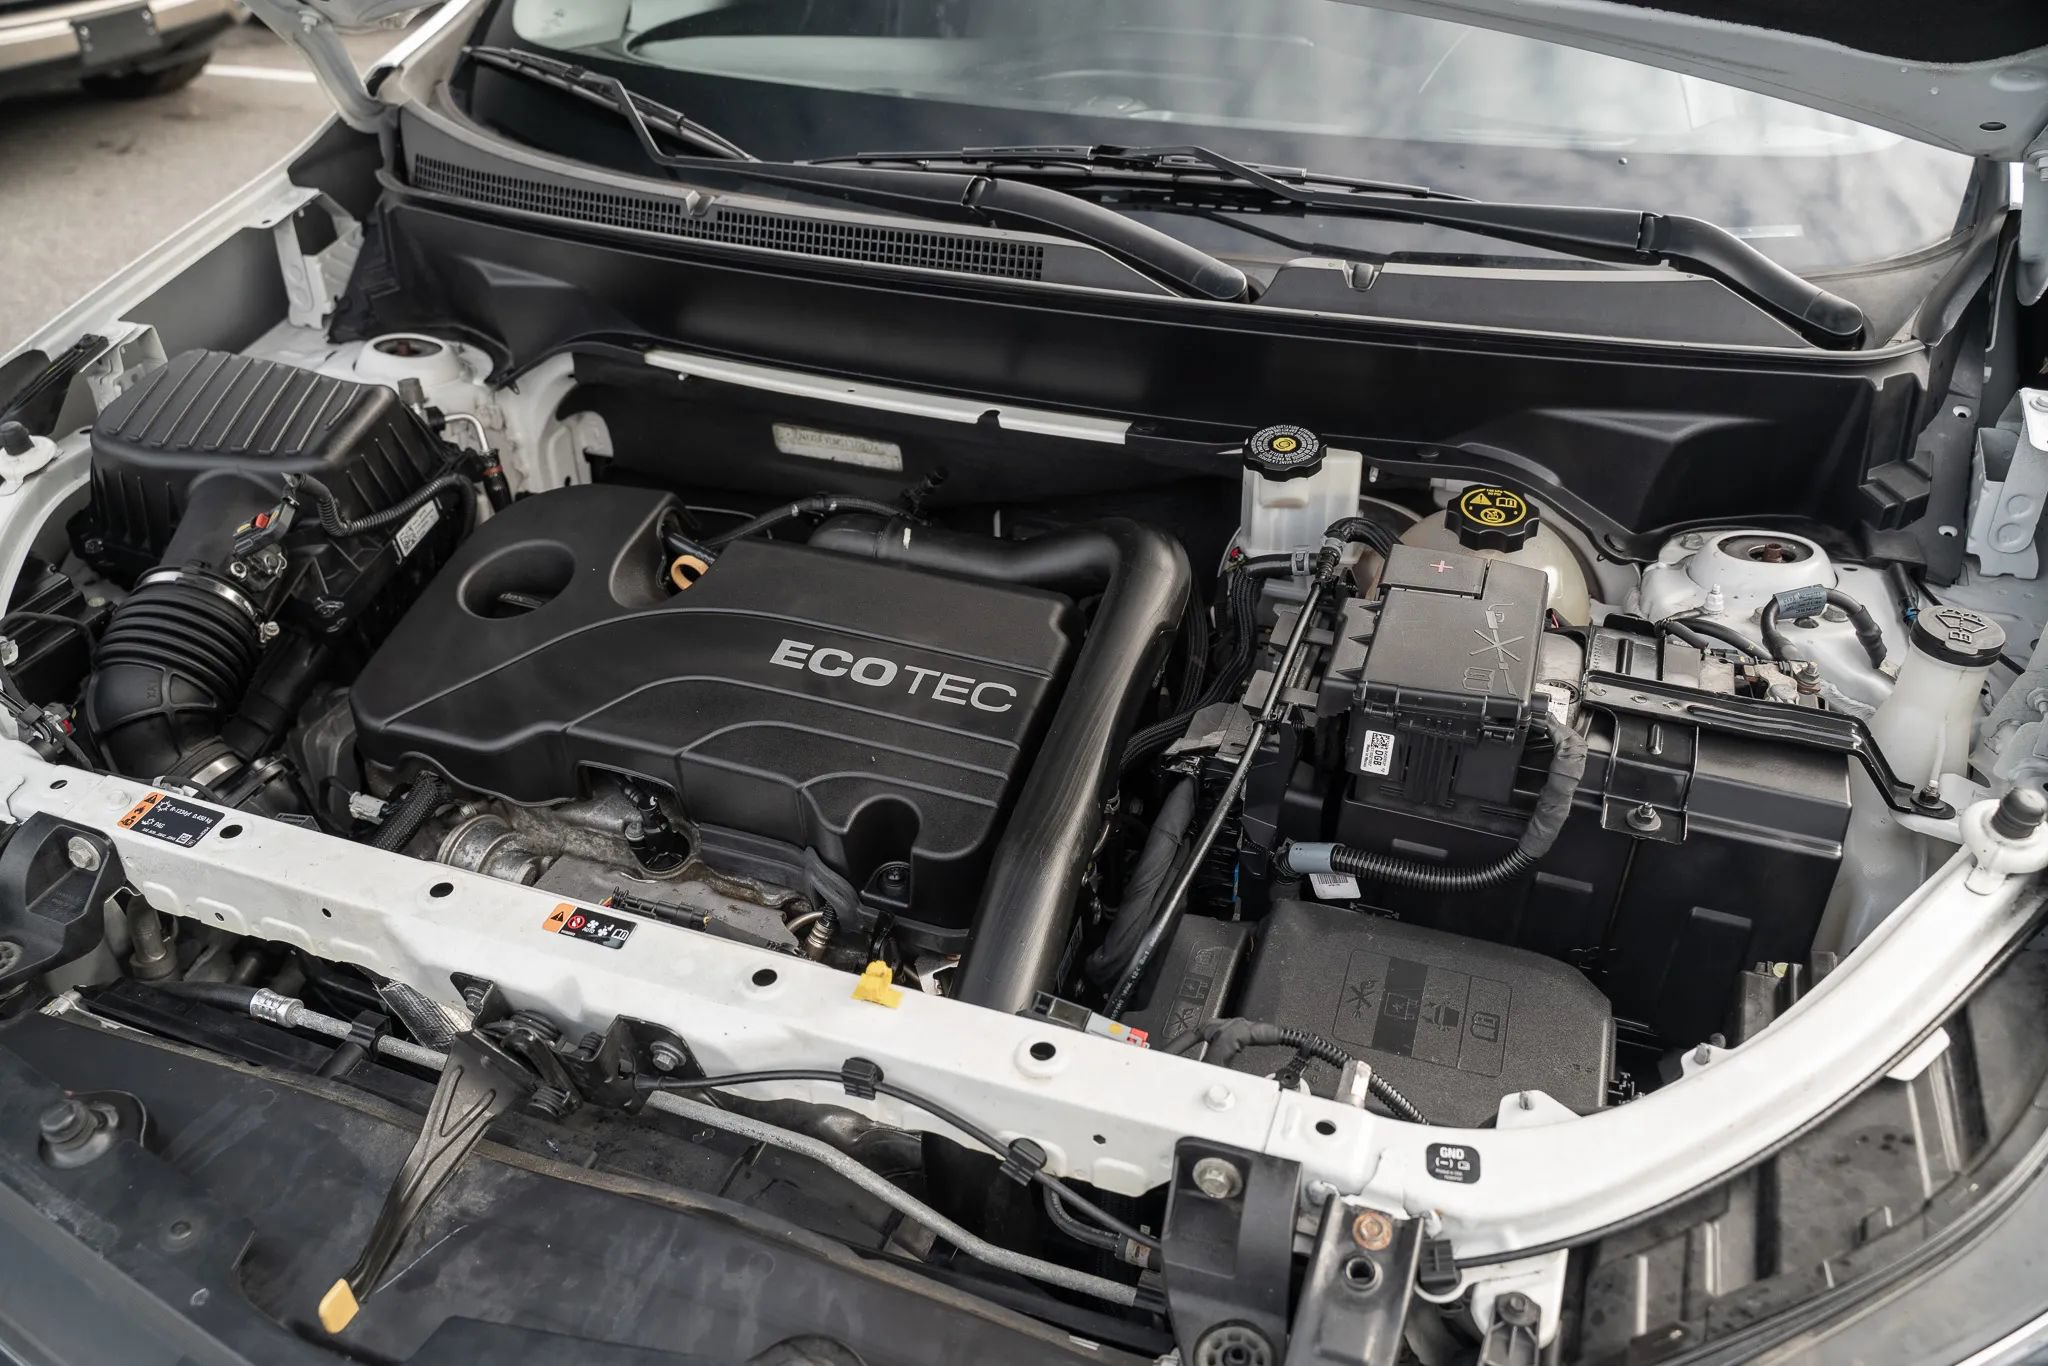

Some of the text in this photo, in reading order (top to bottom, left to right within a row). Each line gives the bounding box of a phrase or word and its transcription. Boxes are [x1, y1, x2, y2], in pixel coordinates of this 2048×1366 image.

[769, 638, 1017, 713] ECOTEC
[1373, 749, 1383, 766] DGB
[1439, 1146, 1465, 1160] GND
